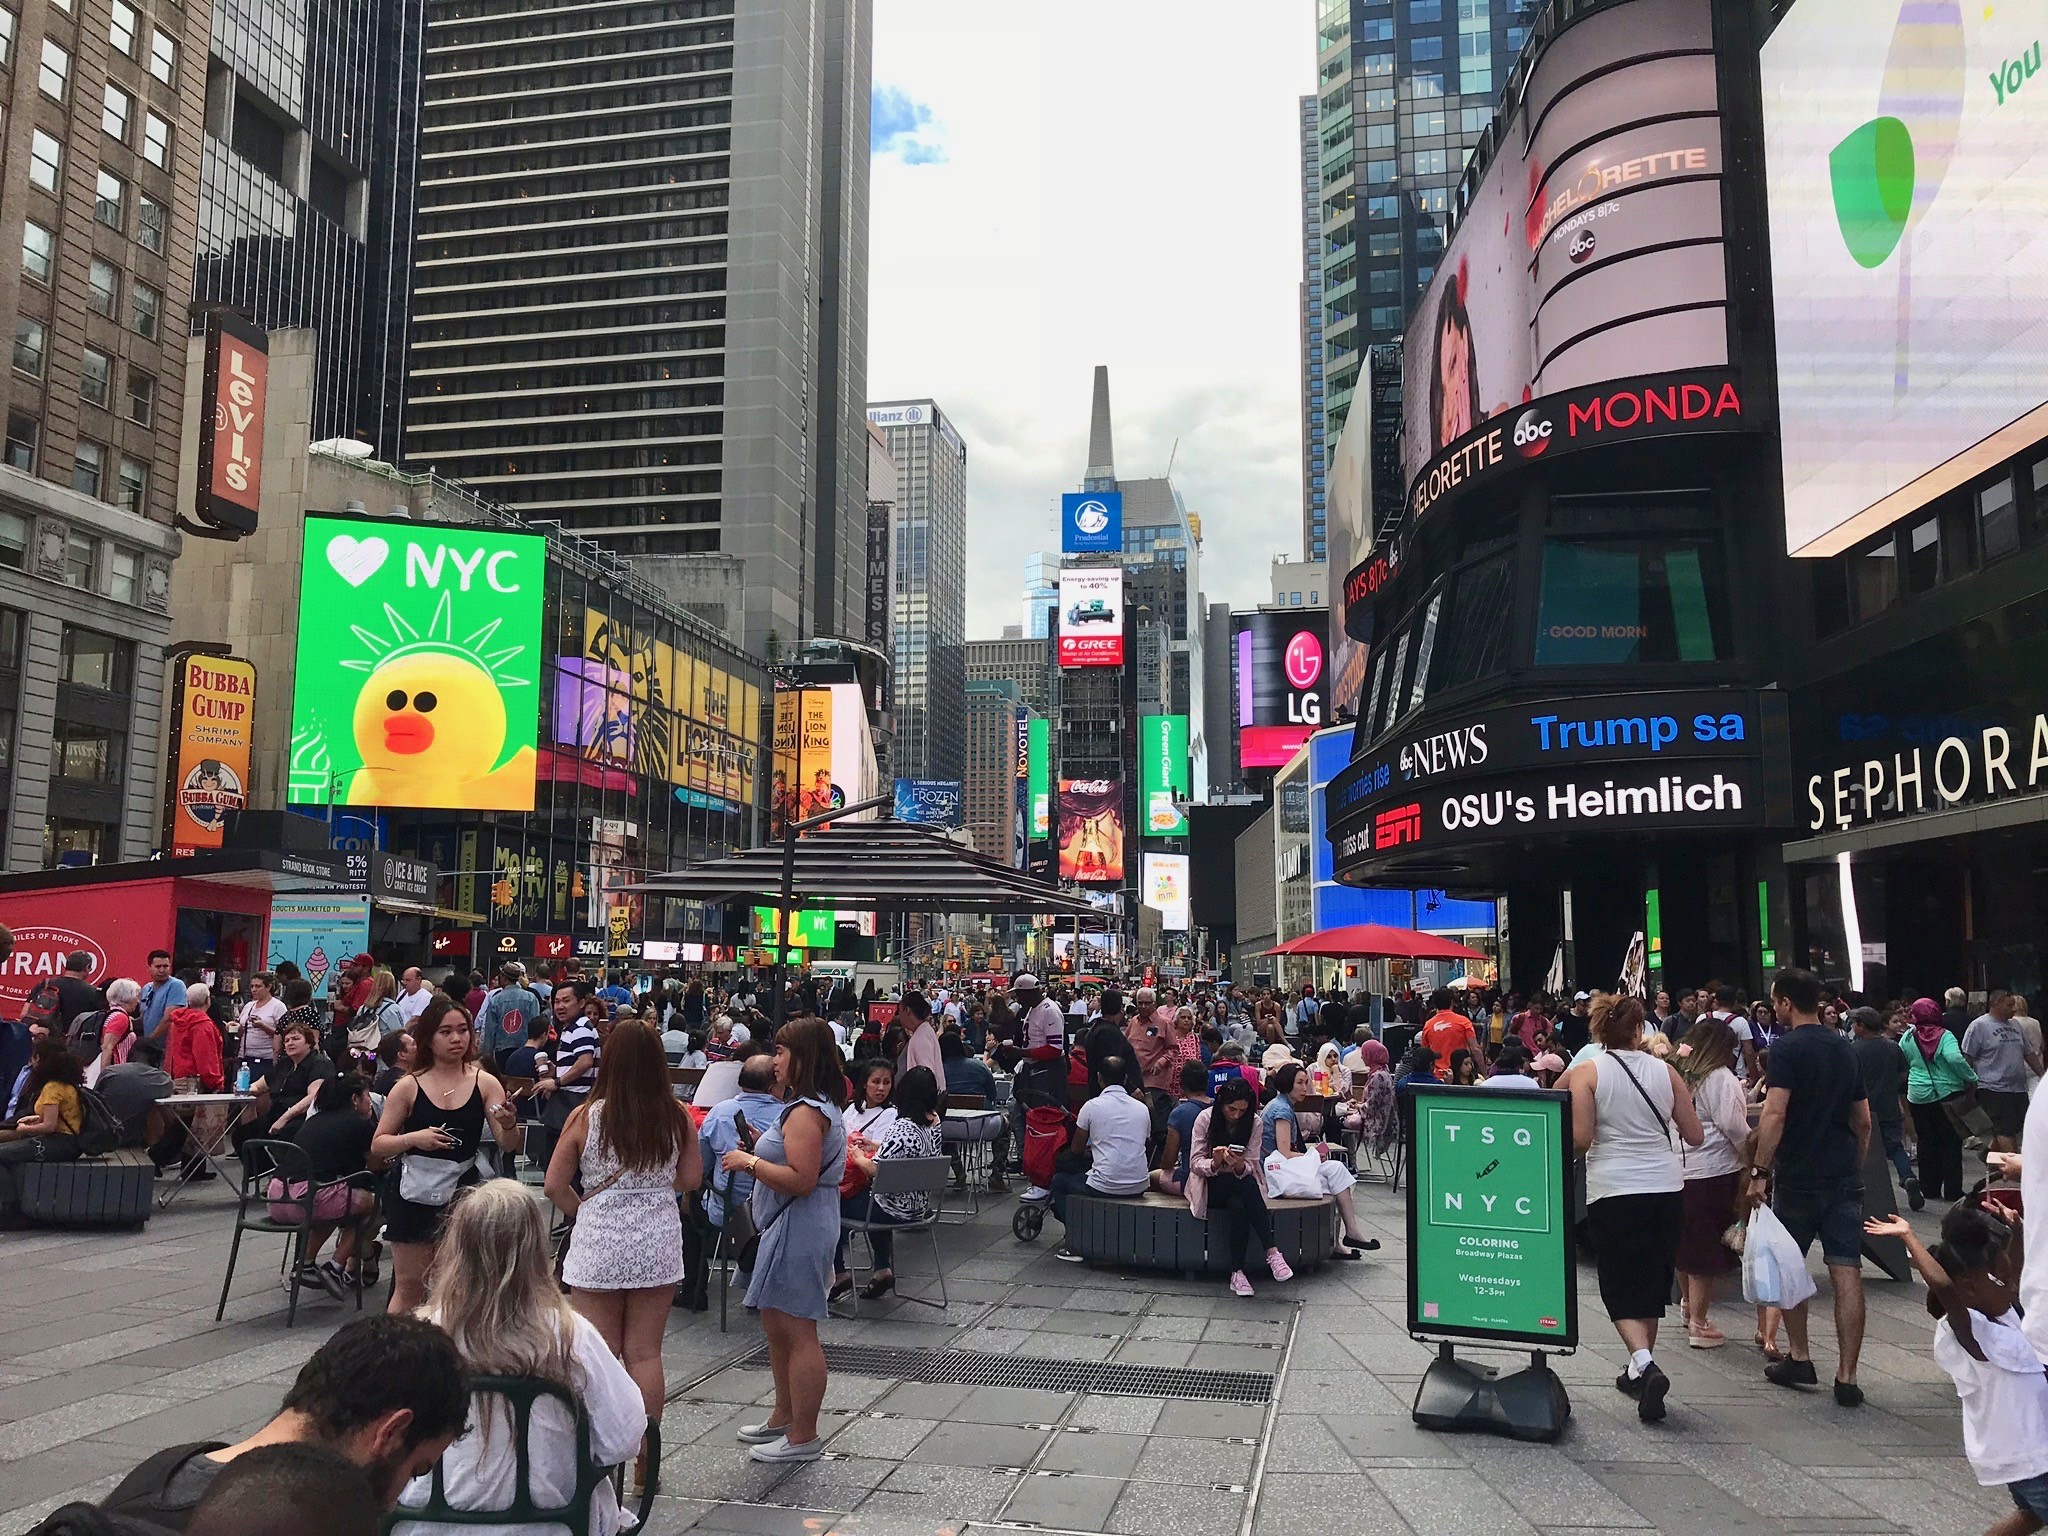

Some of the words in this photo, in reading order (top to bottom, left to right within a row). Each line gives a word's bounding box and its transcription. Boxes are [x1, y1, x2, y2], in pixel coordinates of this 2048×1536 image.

[1988, 40, 2041, 106] You
[1553, 210, 1596, 243] MONDAYS
[1568, 383, 1741, 437] MONDA
[406, 541, 520, 593] NYC
[869, 527, 885, 612] TIMES
[1078, 639, 1117, 650] GREE
[1550, 625, 1597, 639] GOOD
[189, 664, 251, 696] BUBBA
[192, 693, 245, 721] GUMP
[808, 711, 824, 719] THE
[1288, 692, 1321, 725] LG
[195, 724, 240, 736] SHRIMP
[805, 720, 827, 734] LION
[1160, 720, 1172, 758] Green
[1531, 714, 1679, 751] Trump
[1693, 713, 1745, 742] sa
[188, 734, 244, 747] COMPANY
[803, 737, 829, 748] KING
[1016, 714, 1029, 778] NOVOTEL
[1412, 723, 1489, 779] NEWS
[1808, 713, 2048, 830] SEPHORA
[912, 787, 959, 805] FROZEN
[1070, 780, 1110, 794] Coca-Cola
[182, 791, 215, 804] BUBBA
[216, 791, 241, 809] GUM
[1441, 790, 1536, 831] OSU's
[1547, 774, 1743, 821] Heimlich
[1358, 823, 1370, 852] cut
[1376, 802, 1421, 851] ESPN
[282, 859, 302, 872] STRAND
[302, 863, 316, 875] BOOK
[316, 866, 331, 878] STORE
[395, 860, 406, 879] ICE
[406, 863, 412, 880] &
[413, 864, 427, 883] VICE
[52, 933, 79, 946] BOOKS
[1455, 1248, 1496, 1260] Broadway
[1497, 1251, 1524, 1261] Plazas
[1458, 1236, 1520, 1250] COLORING
[1458, 1273, 1522, 1288] Wednesdays
